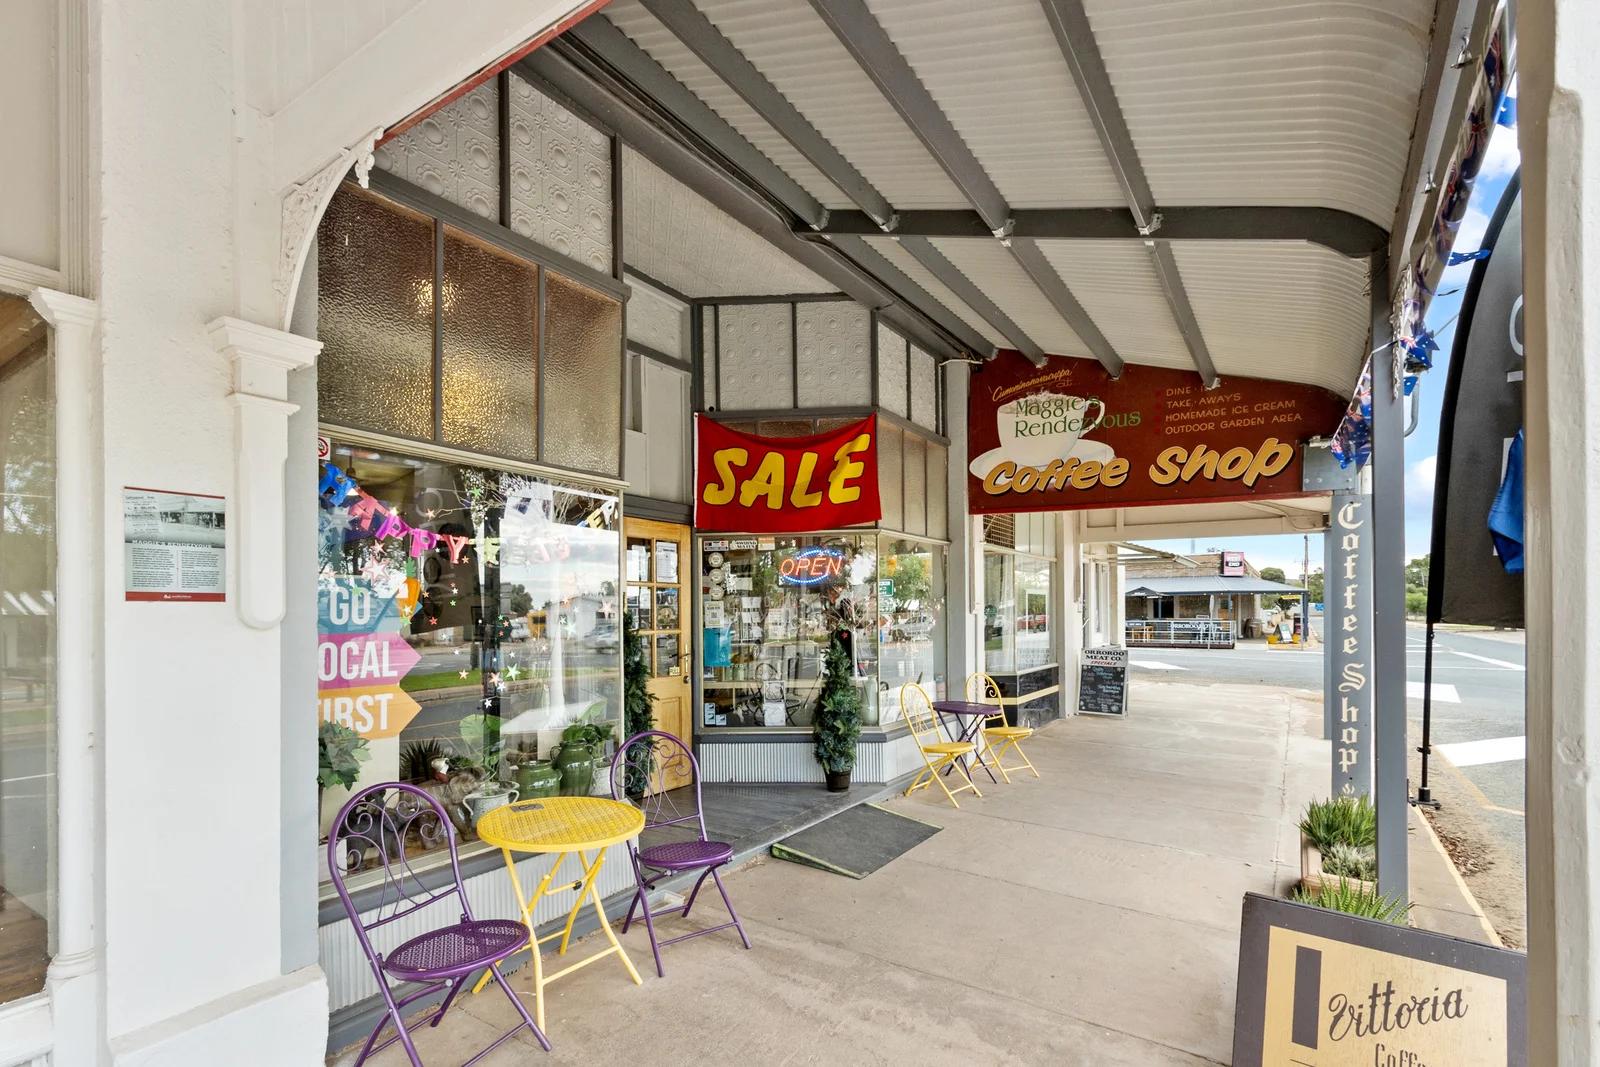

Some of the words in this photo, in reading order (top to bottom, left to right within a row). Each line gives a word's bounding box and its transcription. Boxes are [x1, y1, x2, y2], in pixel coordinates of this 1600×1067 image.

[1015, 391, 1101, 419] Maggie's
[1165, 407, 1227, 422] HOMEMADE
[1231, 405, 1249, 415] ICE
[1254, 400, 1296, 412] CREAM
[1166, 386, 1192, 397] DINE
[1166, 399, 1192, 409] TAKE
[1198, 393, 1241, 405] AWAYS
[1014, 411, 1141, 438] Rendezvous
[1165, 422, 1216, 435] OUTDOOR
[1220, 417, 1265, 429] GARDEN
[1271, 413, 1302, 424] AREA
[702, 433, 871, 510] SALE
[983, 456, 1130, 496] Coffee
[318, 462, 469, 564] HAPPY
[780, 557, 842, 577] OPEN
[1337, 502, 1365, 654] Coffee
[329, 586, 371, 625] GO
[318, 640, 398, 682] OCAL
[318, 692, 394, 734] IRST
[1338, 662, 1366, 774] Shop
[1328, 980, 1469, 1042] Vittoria
[1375, 1043, 1432, 1067] Coff
